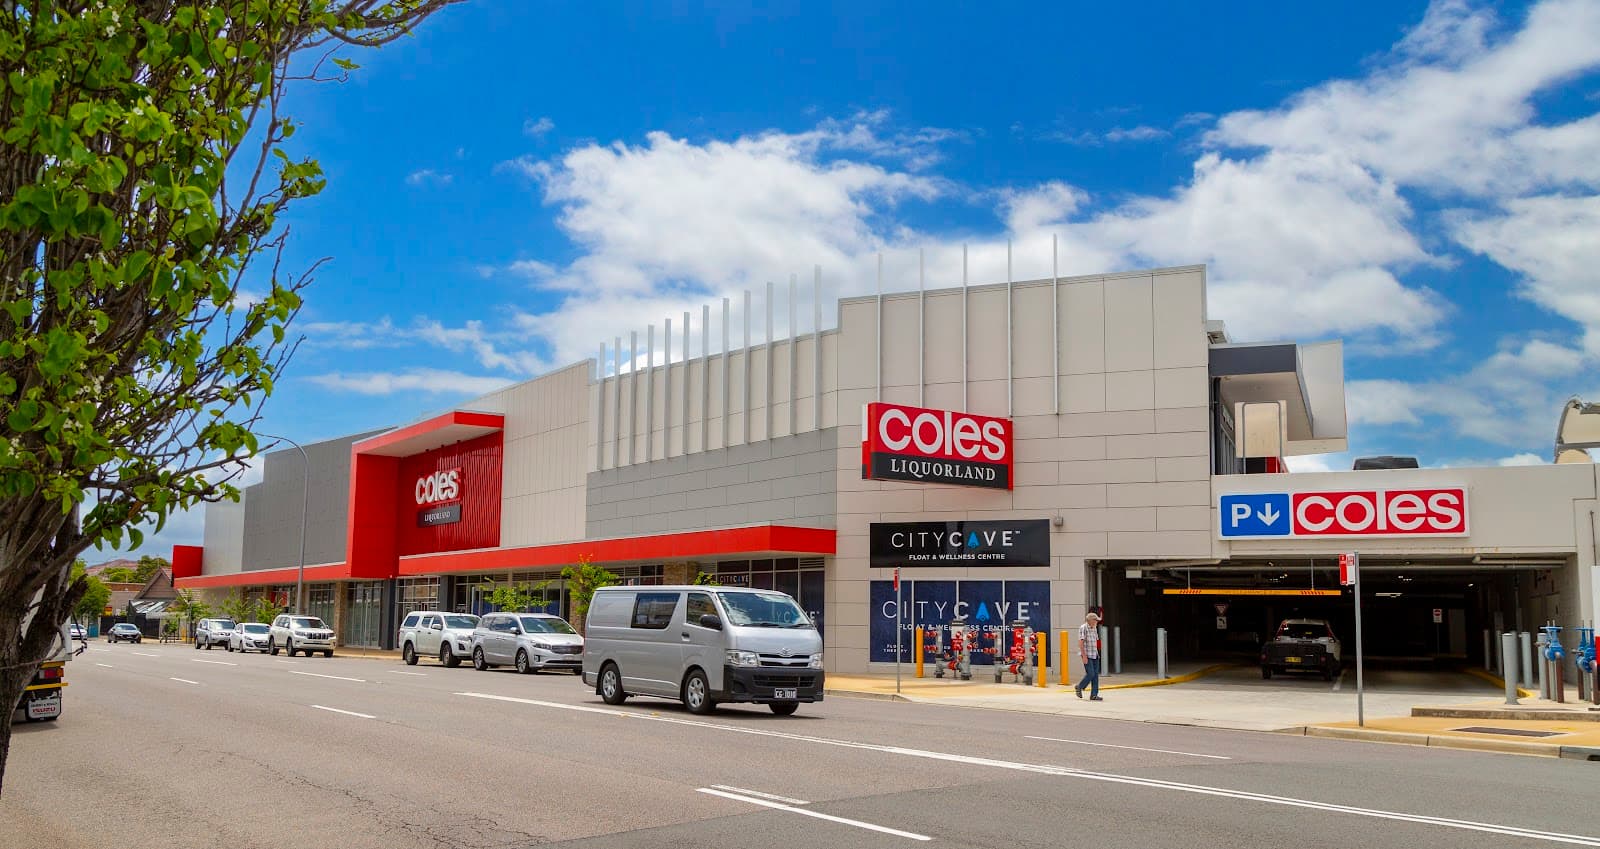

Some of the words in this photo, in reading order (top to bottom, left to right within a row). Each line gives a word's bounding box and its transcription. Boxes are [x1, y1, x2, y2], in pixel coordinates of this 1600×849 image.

[879, 408, 1006, 461] coles
[415, 470, 459, 504] coles
[891, 458, 996, 481] LIQUORLAND
[1231, 503, 1251, 527] P
[1296, 491, 1461, 532] coles
